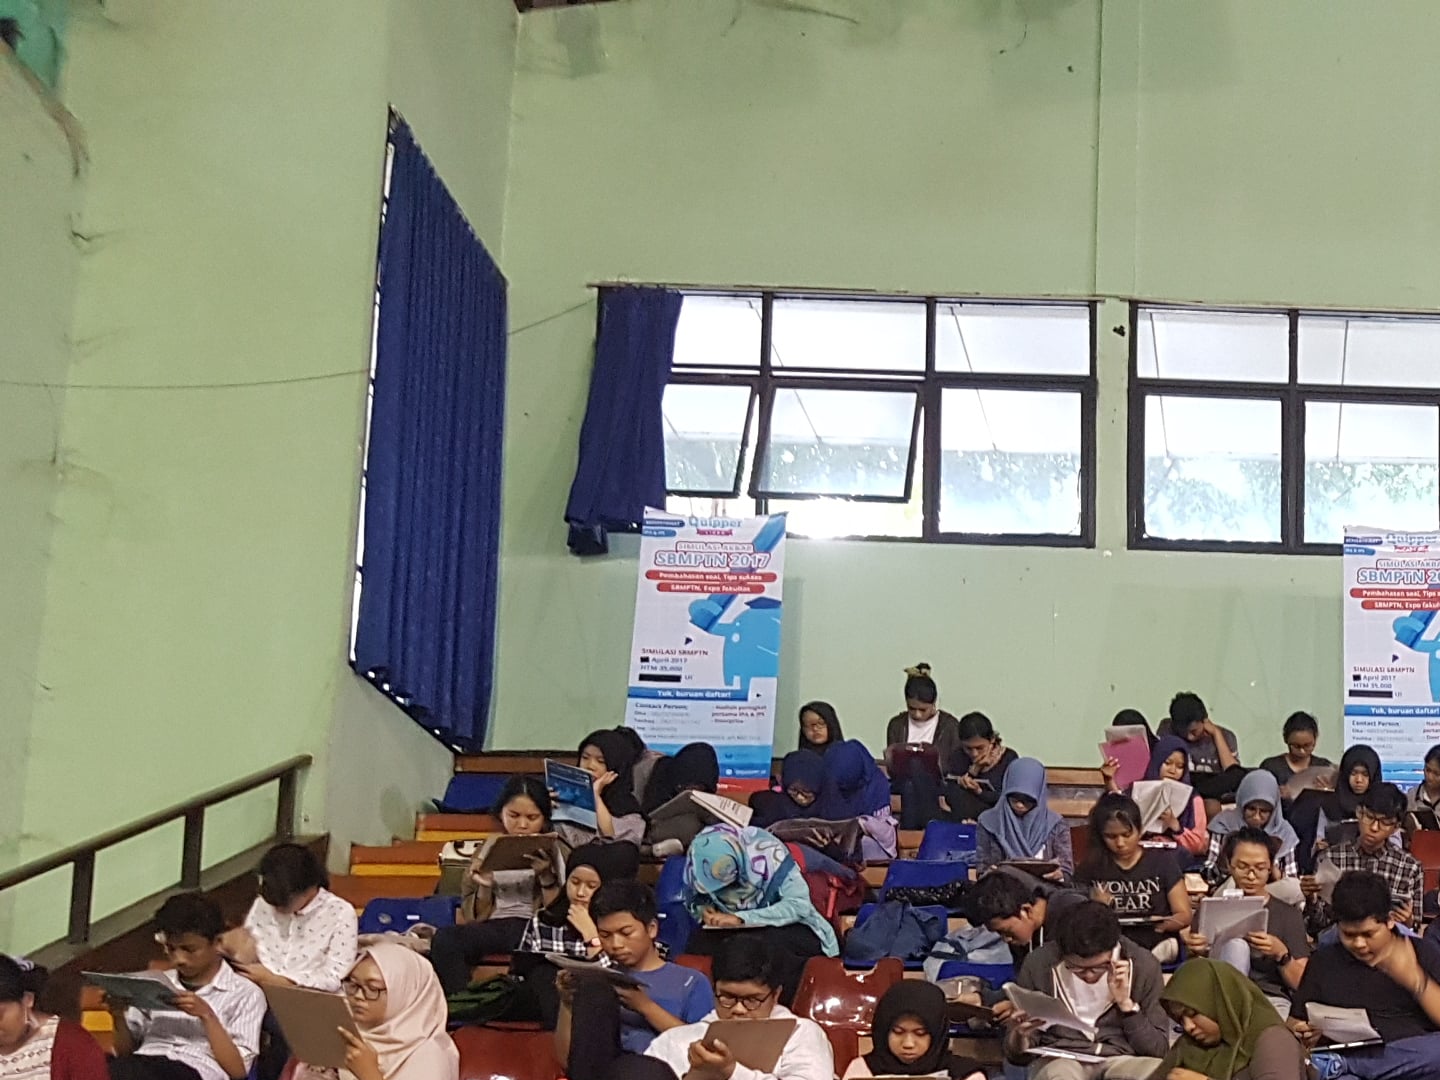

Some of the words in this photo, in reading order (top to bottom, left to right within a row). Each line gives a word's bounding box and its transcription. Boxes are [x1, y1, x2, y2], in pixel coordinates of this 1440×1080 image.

[689, 516, 742, 528] Quipper
[656, 552, 726, 565] SBMPTN
[732, 552, 770, 567] 2017
[1360, 570, 1424, 582] SBMPTN
